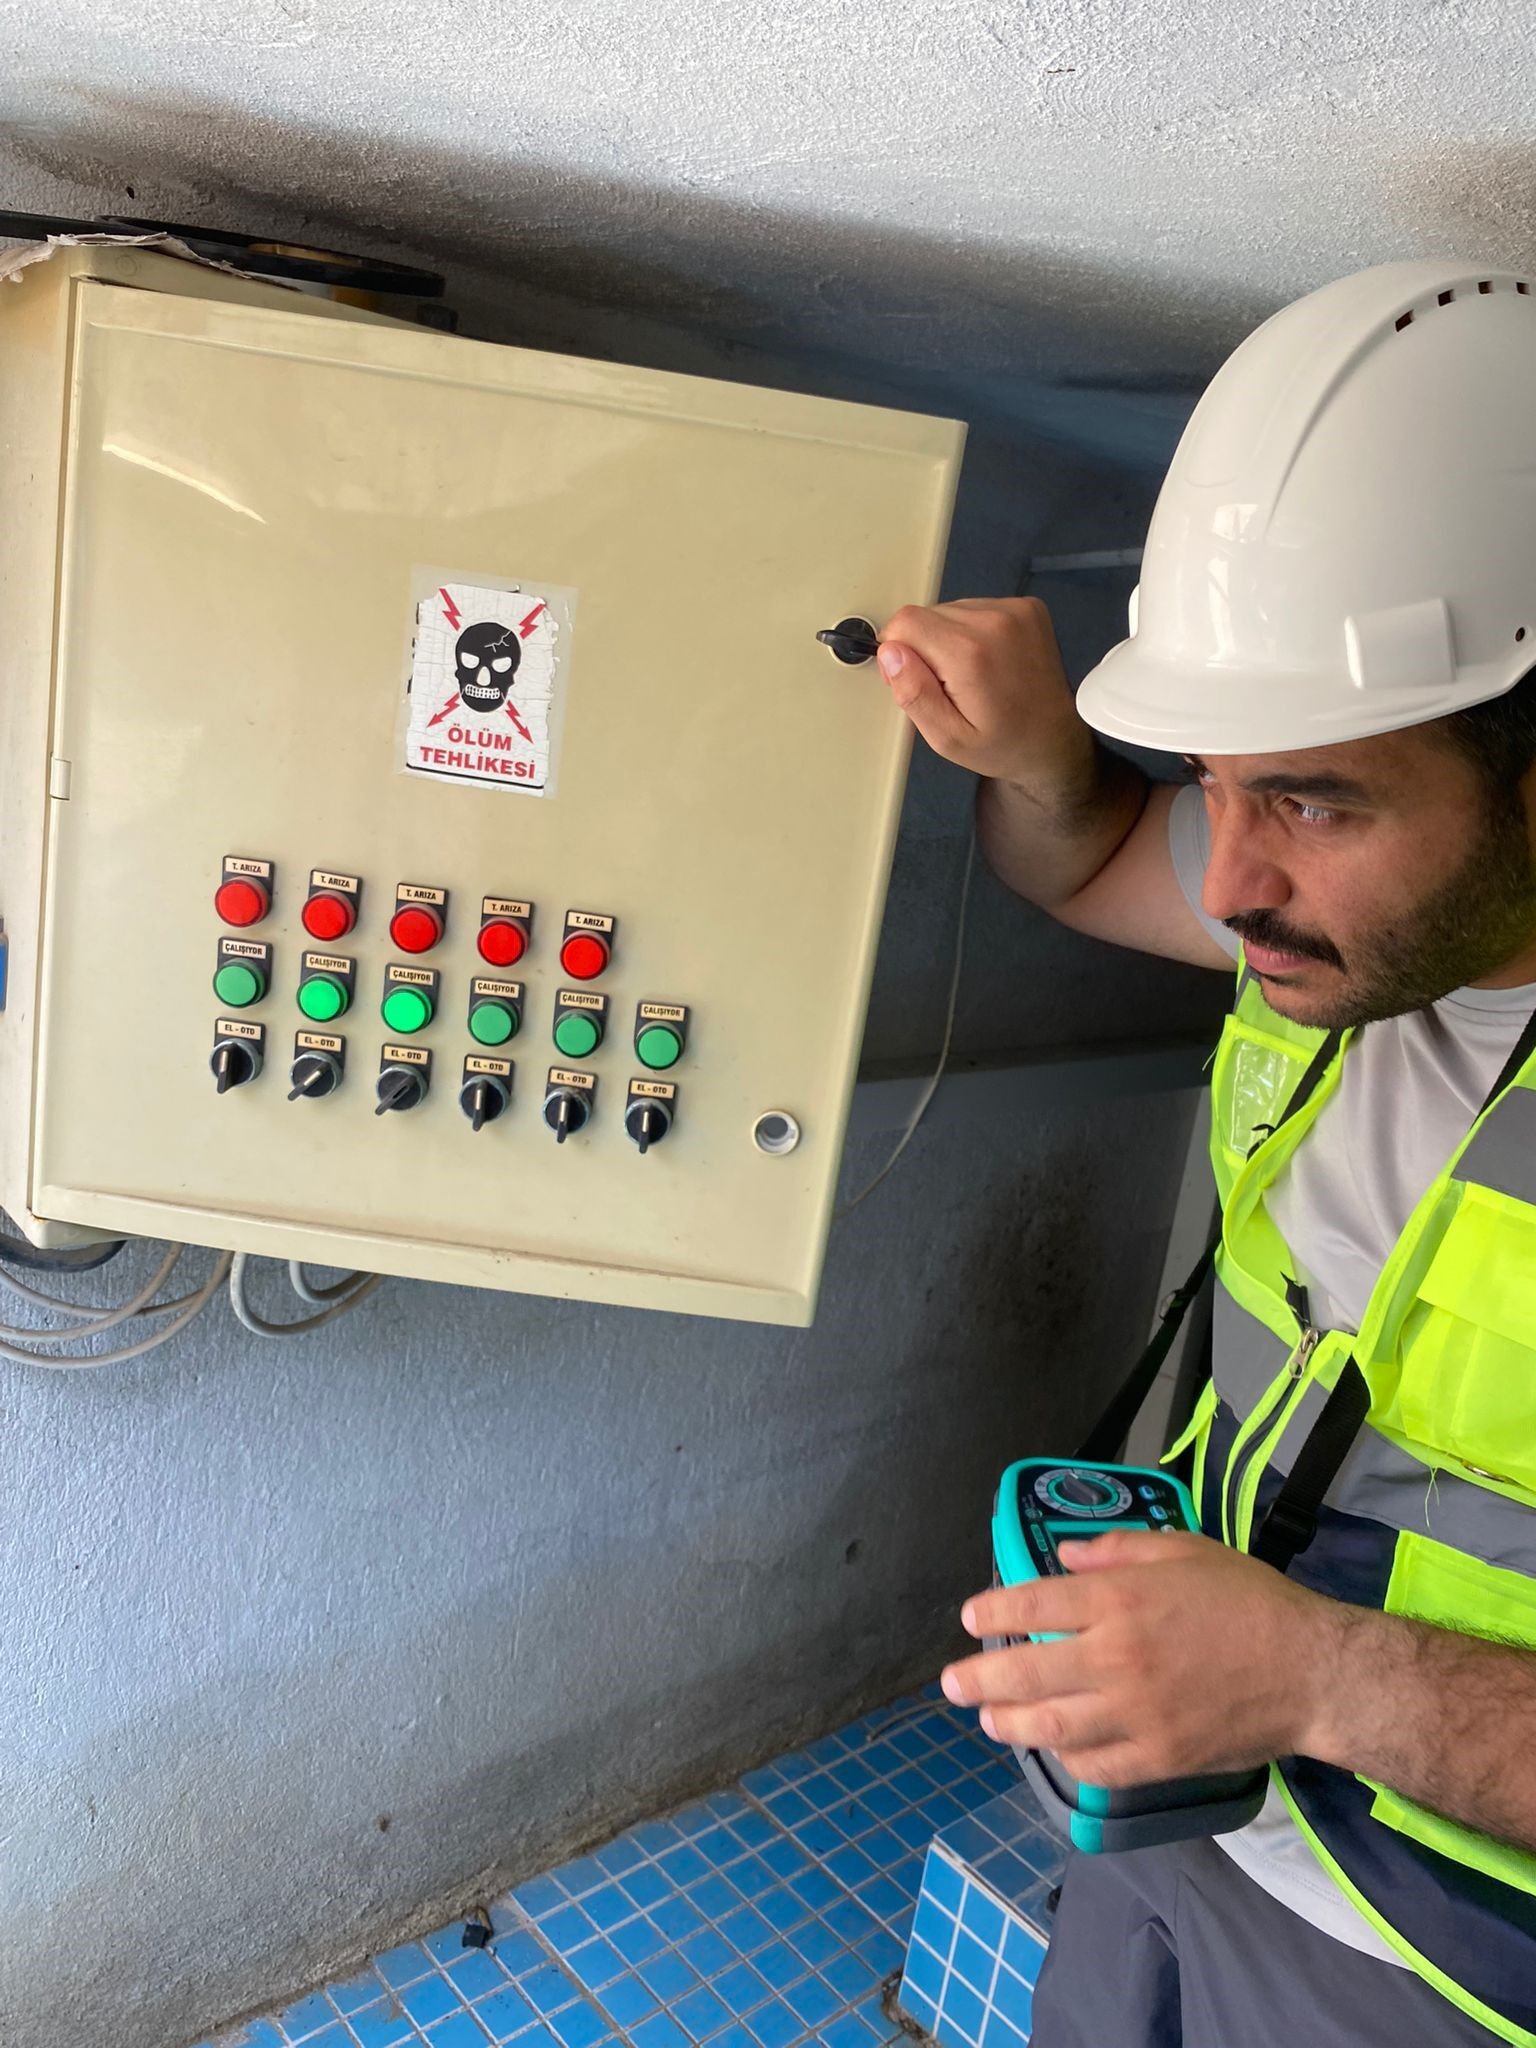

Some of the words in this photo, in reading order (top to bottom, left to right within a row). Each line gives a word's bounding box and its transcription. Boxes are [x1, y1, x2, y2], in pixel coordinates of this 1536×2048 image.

[448, 723, 512, 751] ÖLÜM
[420, 746, 535, 779] TEHLİKESİ
[232, 863, 239, 871] T.
[240, 863, 262, 874] ARIZA
[321, 876, 327, 884] T.
[328, 877, 350, 888] ARIZA
[406, 890, 413, 898] T.
[414, 890, 436, 900] ARIZA
[492, 904, 499, 912] T.
[500, 905, 522, 914] ARIZA
[575, 916, 582, 924] T.
[583, 917, 605, 928] ARIZA
[225, 943, 263, 956] ÇALIŞIYOR
[309, 957, 347, 969] ÇALIŞIYOR
[393, 970, 431, 982] ÇALIŞIYOR
[477, 982, 516, 994] ÇALIŞIYOR
[562, 994, 600, 1006] ÇALIŞIYOR
[643, 1006, 681, 1017] ÇALIŞIYOR
[224, 1024, 235, 1033] EL
[304, 1036, 315, 1045] EL
[391, 1049, 402, 1058] EL
[473, 1061, 483, 1069] EL
[556, 1073, 567, 1081] EL
[637, 1084, 647, 1093] EL
